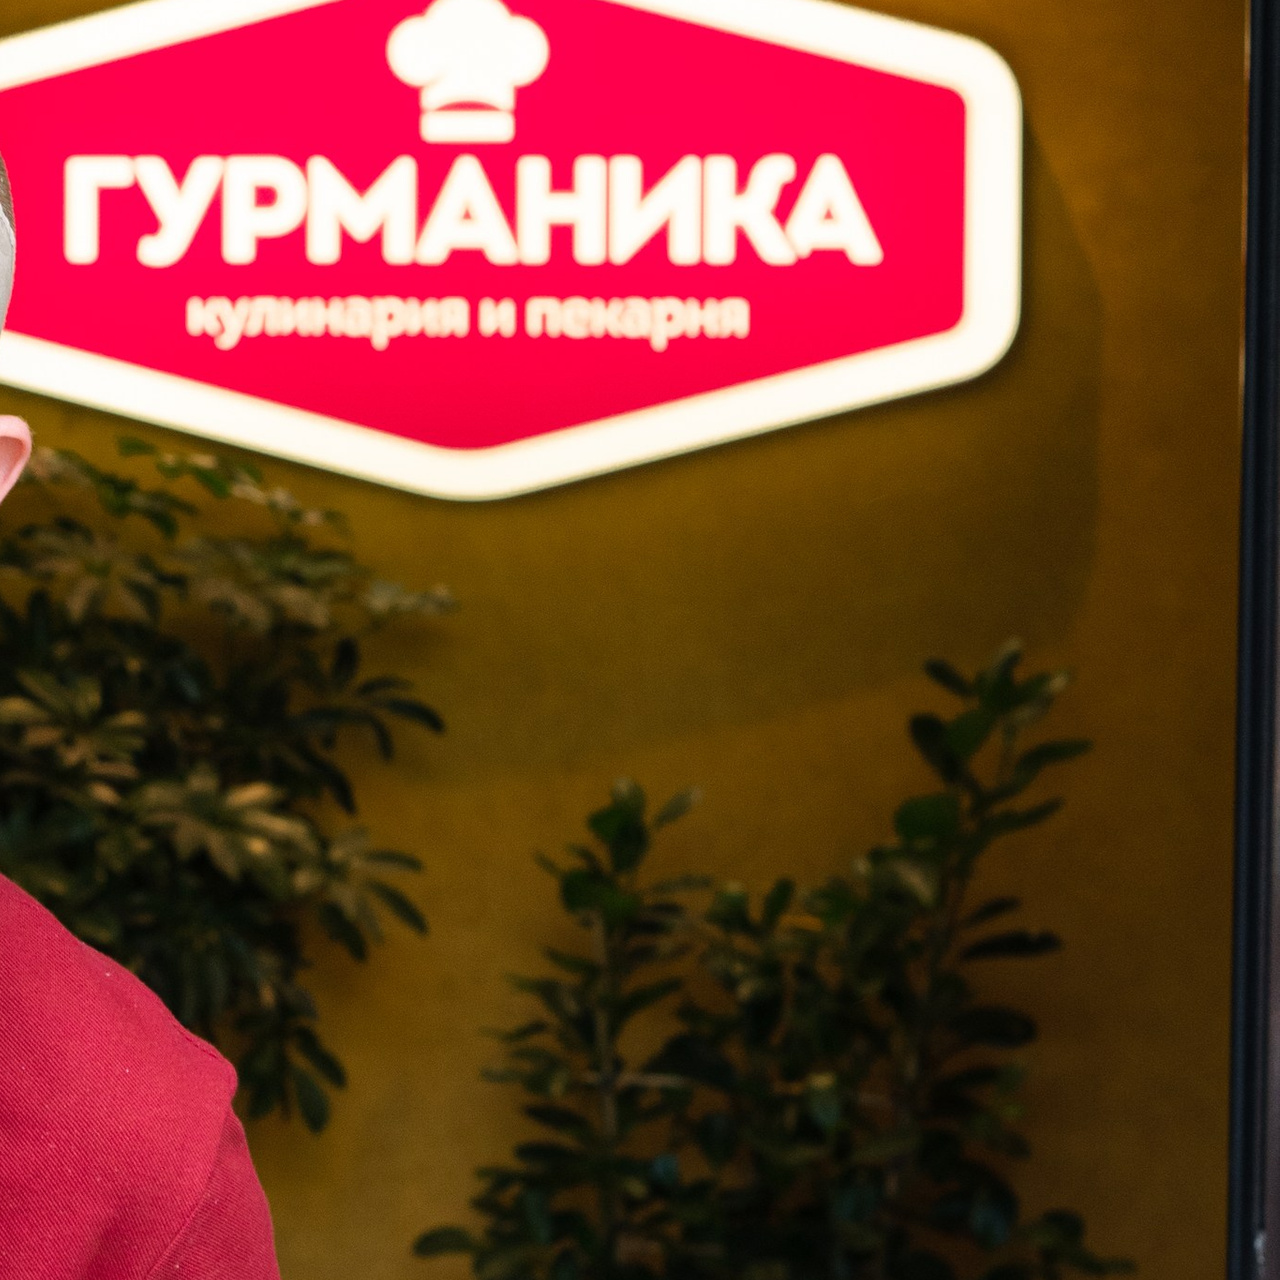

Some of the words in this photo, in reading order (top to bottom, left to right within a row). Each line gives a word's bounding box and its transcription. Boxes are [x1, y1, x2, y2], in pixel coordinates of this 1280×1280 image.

[62, 154, 884, 267] ГУРМАНИКА
[185, 294, 469, 351] кулинария
[480, 298, 517, 338] и
[525, 296, 749, 352] пекарня
